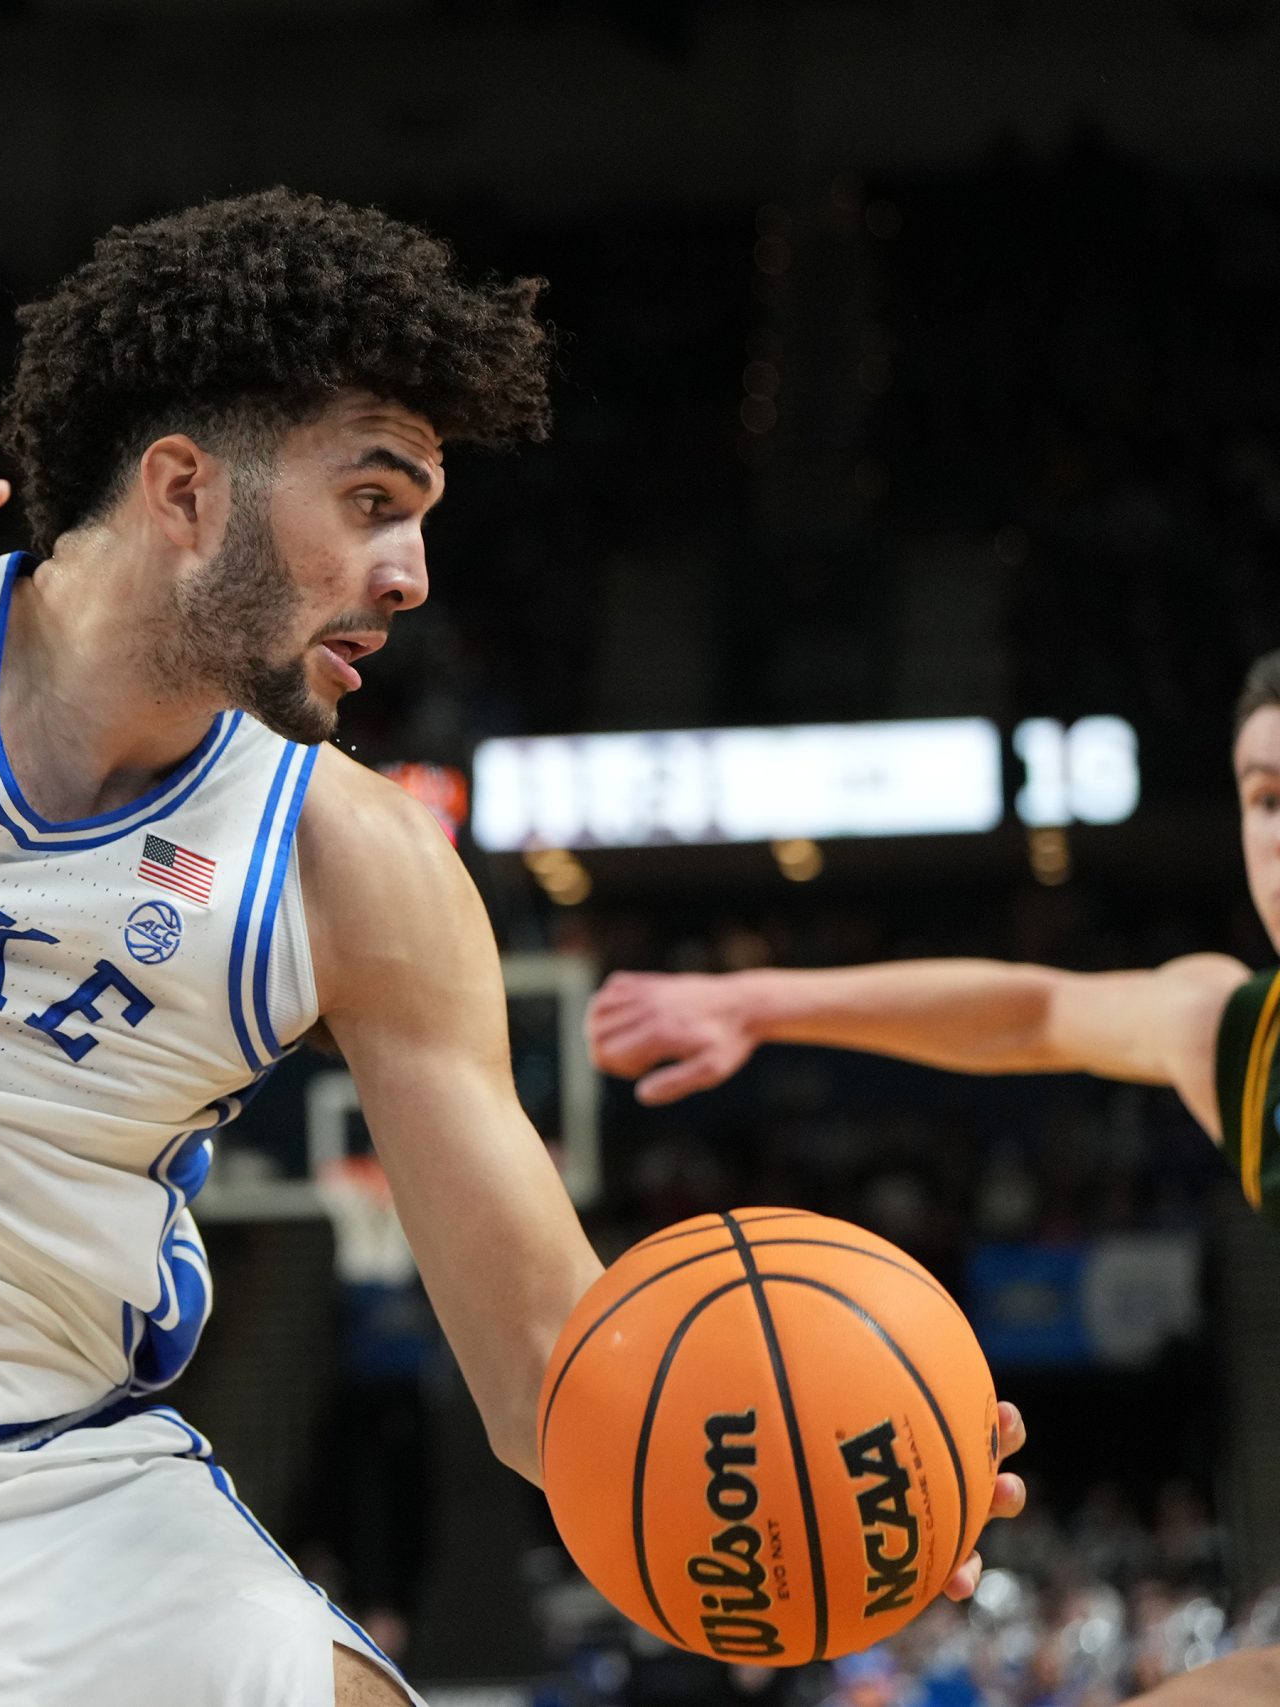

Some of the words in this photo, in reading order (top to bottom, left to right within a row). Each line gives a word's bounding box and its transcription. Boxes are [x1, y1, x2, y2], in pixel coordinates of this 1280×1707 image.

[135, 920, 180, 946] ACC
[687, 1408, 785, 1658] Wilson
[839, 1418, 920, 1618] NCAA
